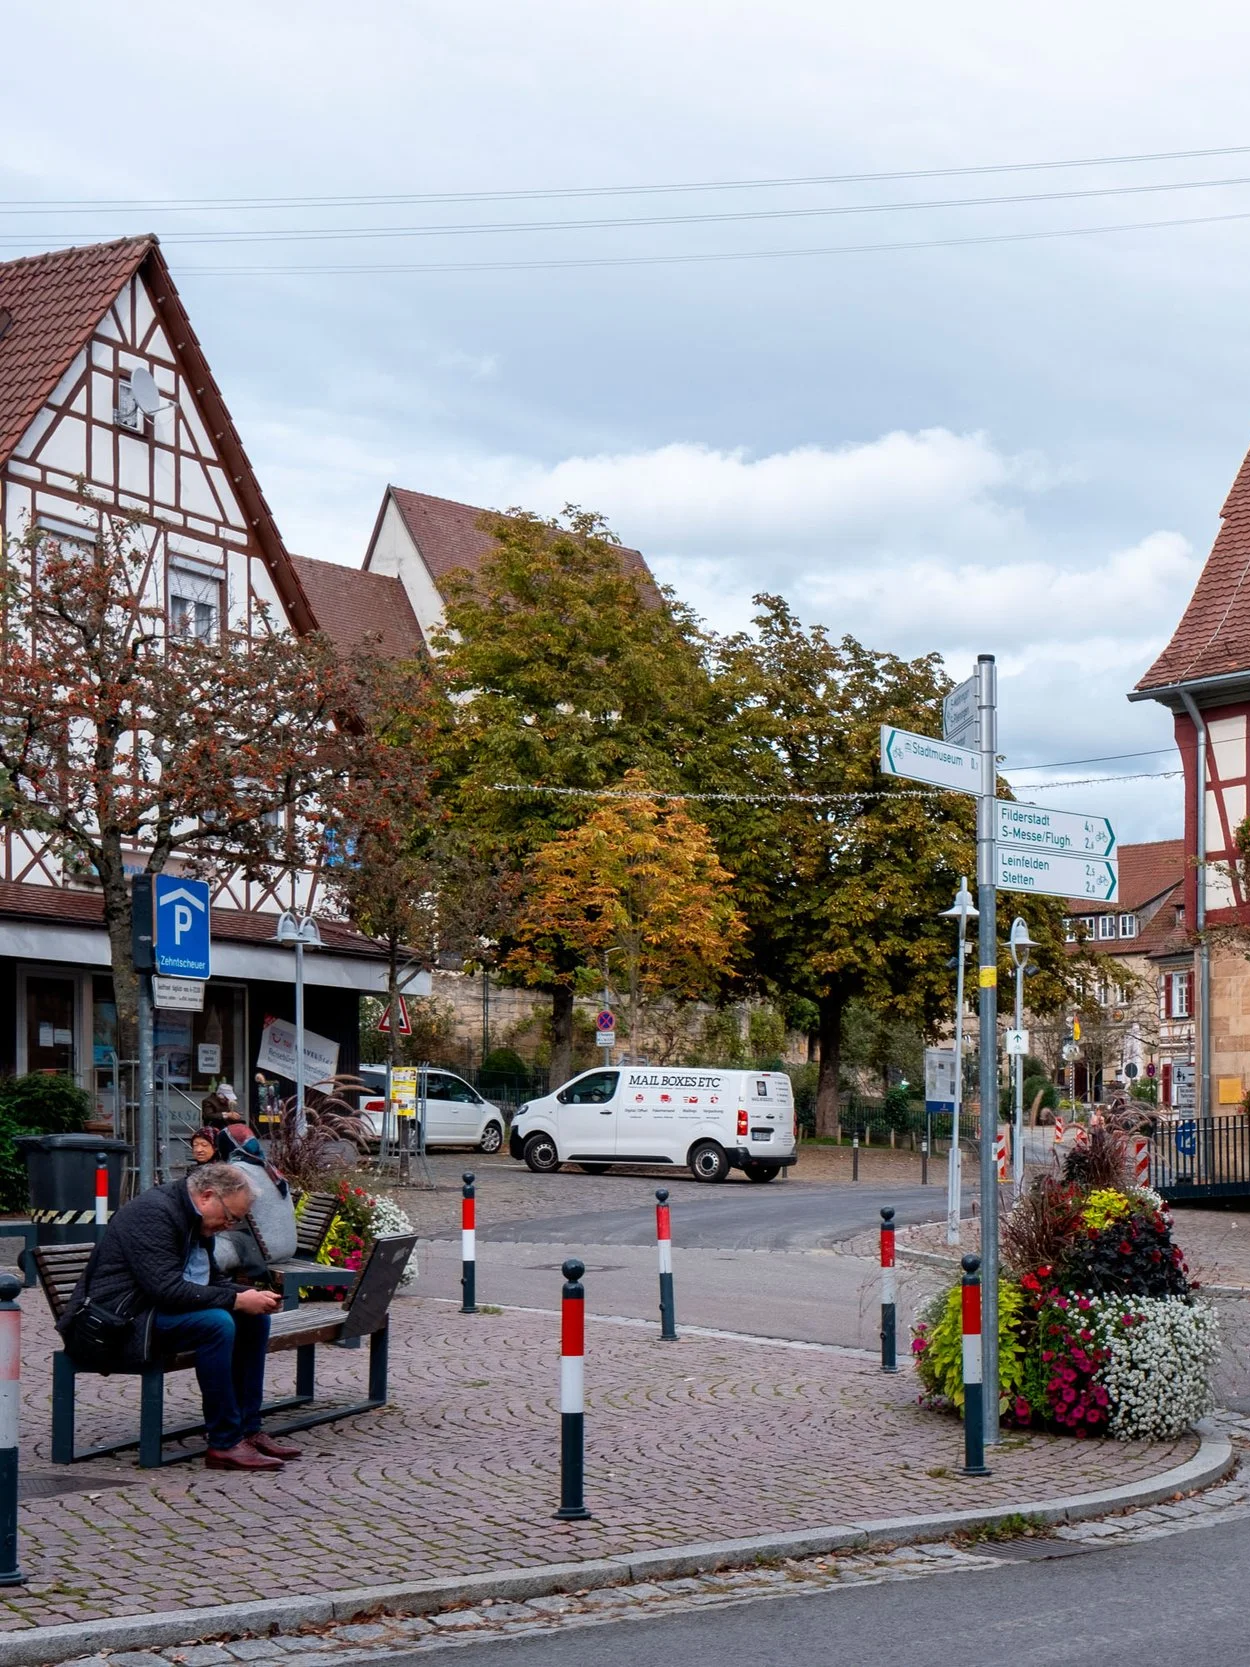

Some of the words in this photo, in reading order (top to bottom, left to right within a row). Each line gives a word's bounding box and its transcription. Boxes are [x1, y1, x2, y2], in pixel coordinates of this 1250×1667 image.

[912, 741, 963, 766] Stadtmuseum
[1001, 808, 1050, 827] Filderstadt
[1001, 825, 1073, 847] S-Messe/Flugh.
[1001, 854, 1050, 871] Leinfelden
[1002, 870, 1035, 886] Stetten
[174, 904, 193, 946] P
[160, 955, 206, 970] Zehntscheuer
[629, 1075, 659, 1086] MAIL
[661, 1076, 696, 1087] BOXES
[698, 1077, 721, 1088] ETC
